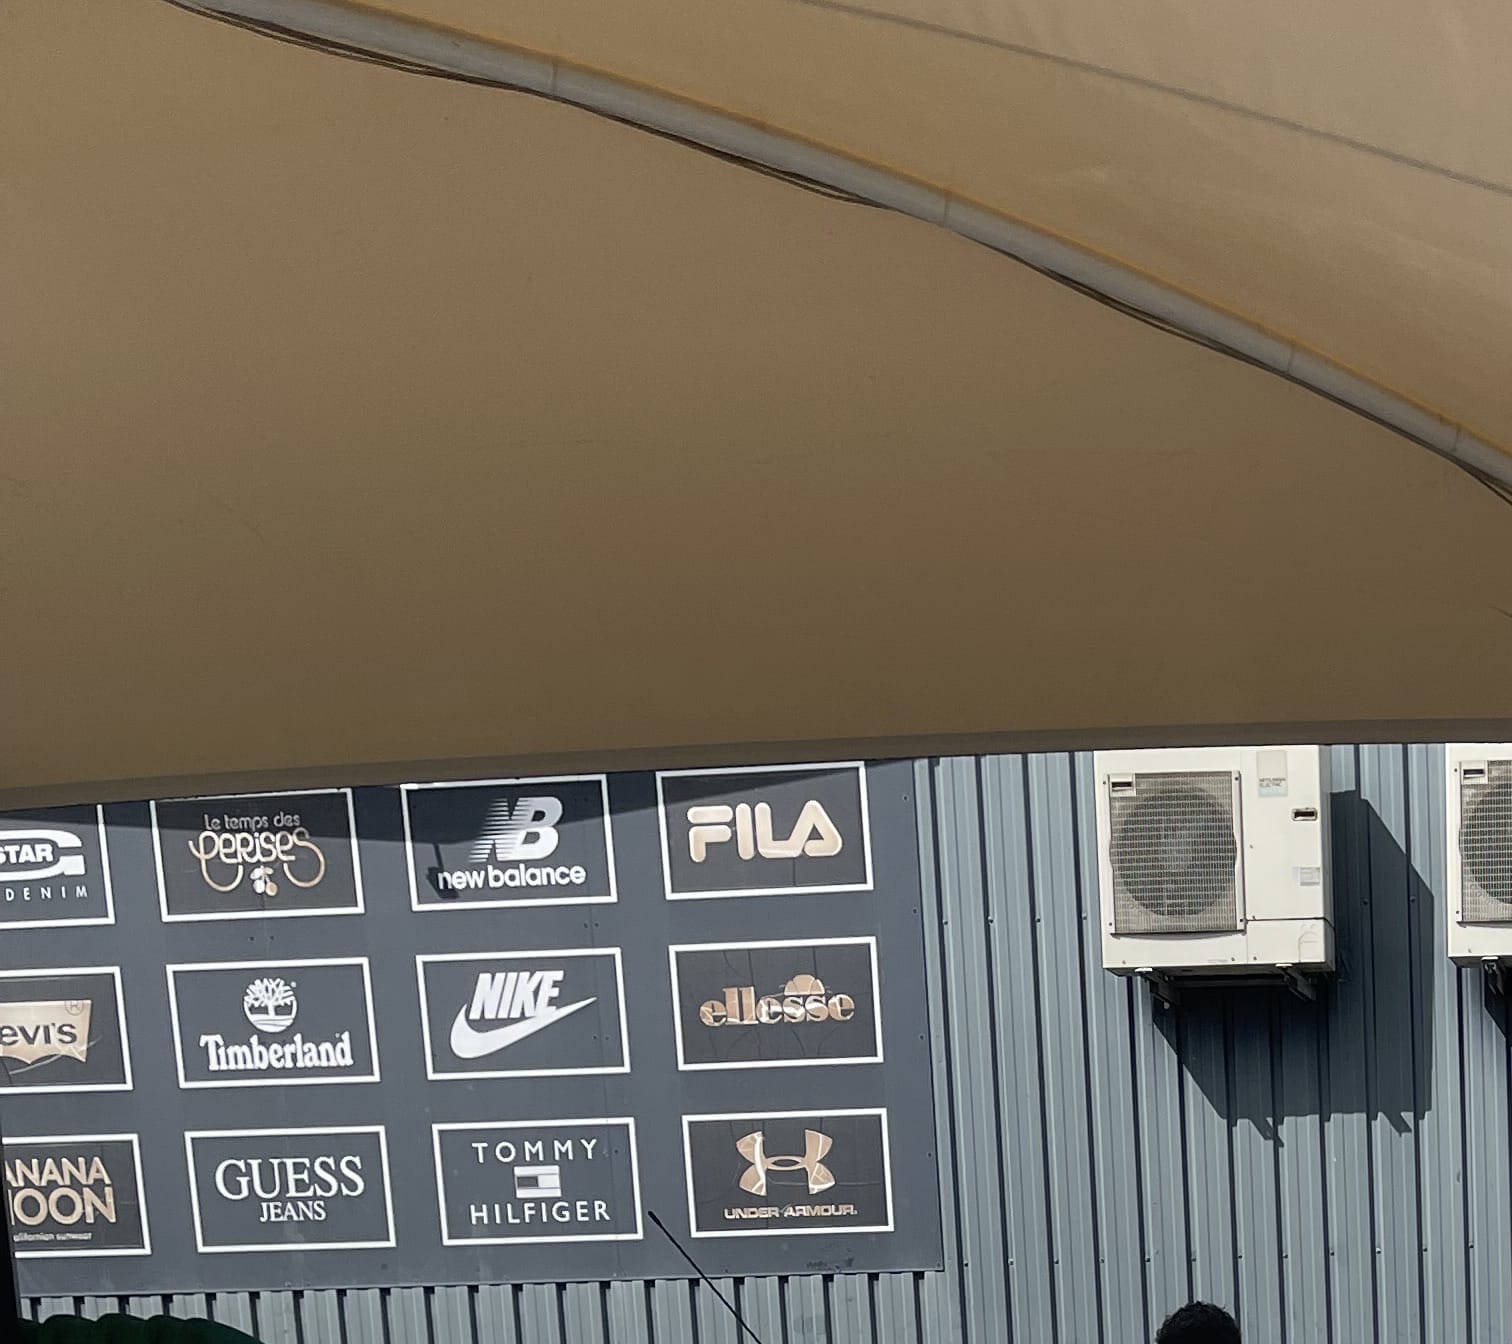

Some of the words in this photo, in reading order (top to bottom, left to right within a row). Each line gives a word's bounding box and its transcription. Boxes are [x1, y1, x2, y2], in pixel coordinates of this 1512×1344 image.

[223, 813, 269, 833] temps
[273, 810, 301, 827] des
[687, 800, 843, 863] FILA
[489, 864, 587, 889] balance
[5, 885, 88, 902] DENIM
[468, 971, 564, 1020] NIKE
[699, 986, 855, 1027] ellesse
[200, 1031, 354, 1072] Timberland
[472, 1139, 598, 1163] TOMMY
[215, 1156, 365, 1201] GUESS
[260, 1202, 327, 1223] JEANS
[470, 1200, 611, 1224] HILFIGER
[723, 1207, 780, 1220] UNDER
